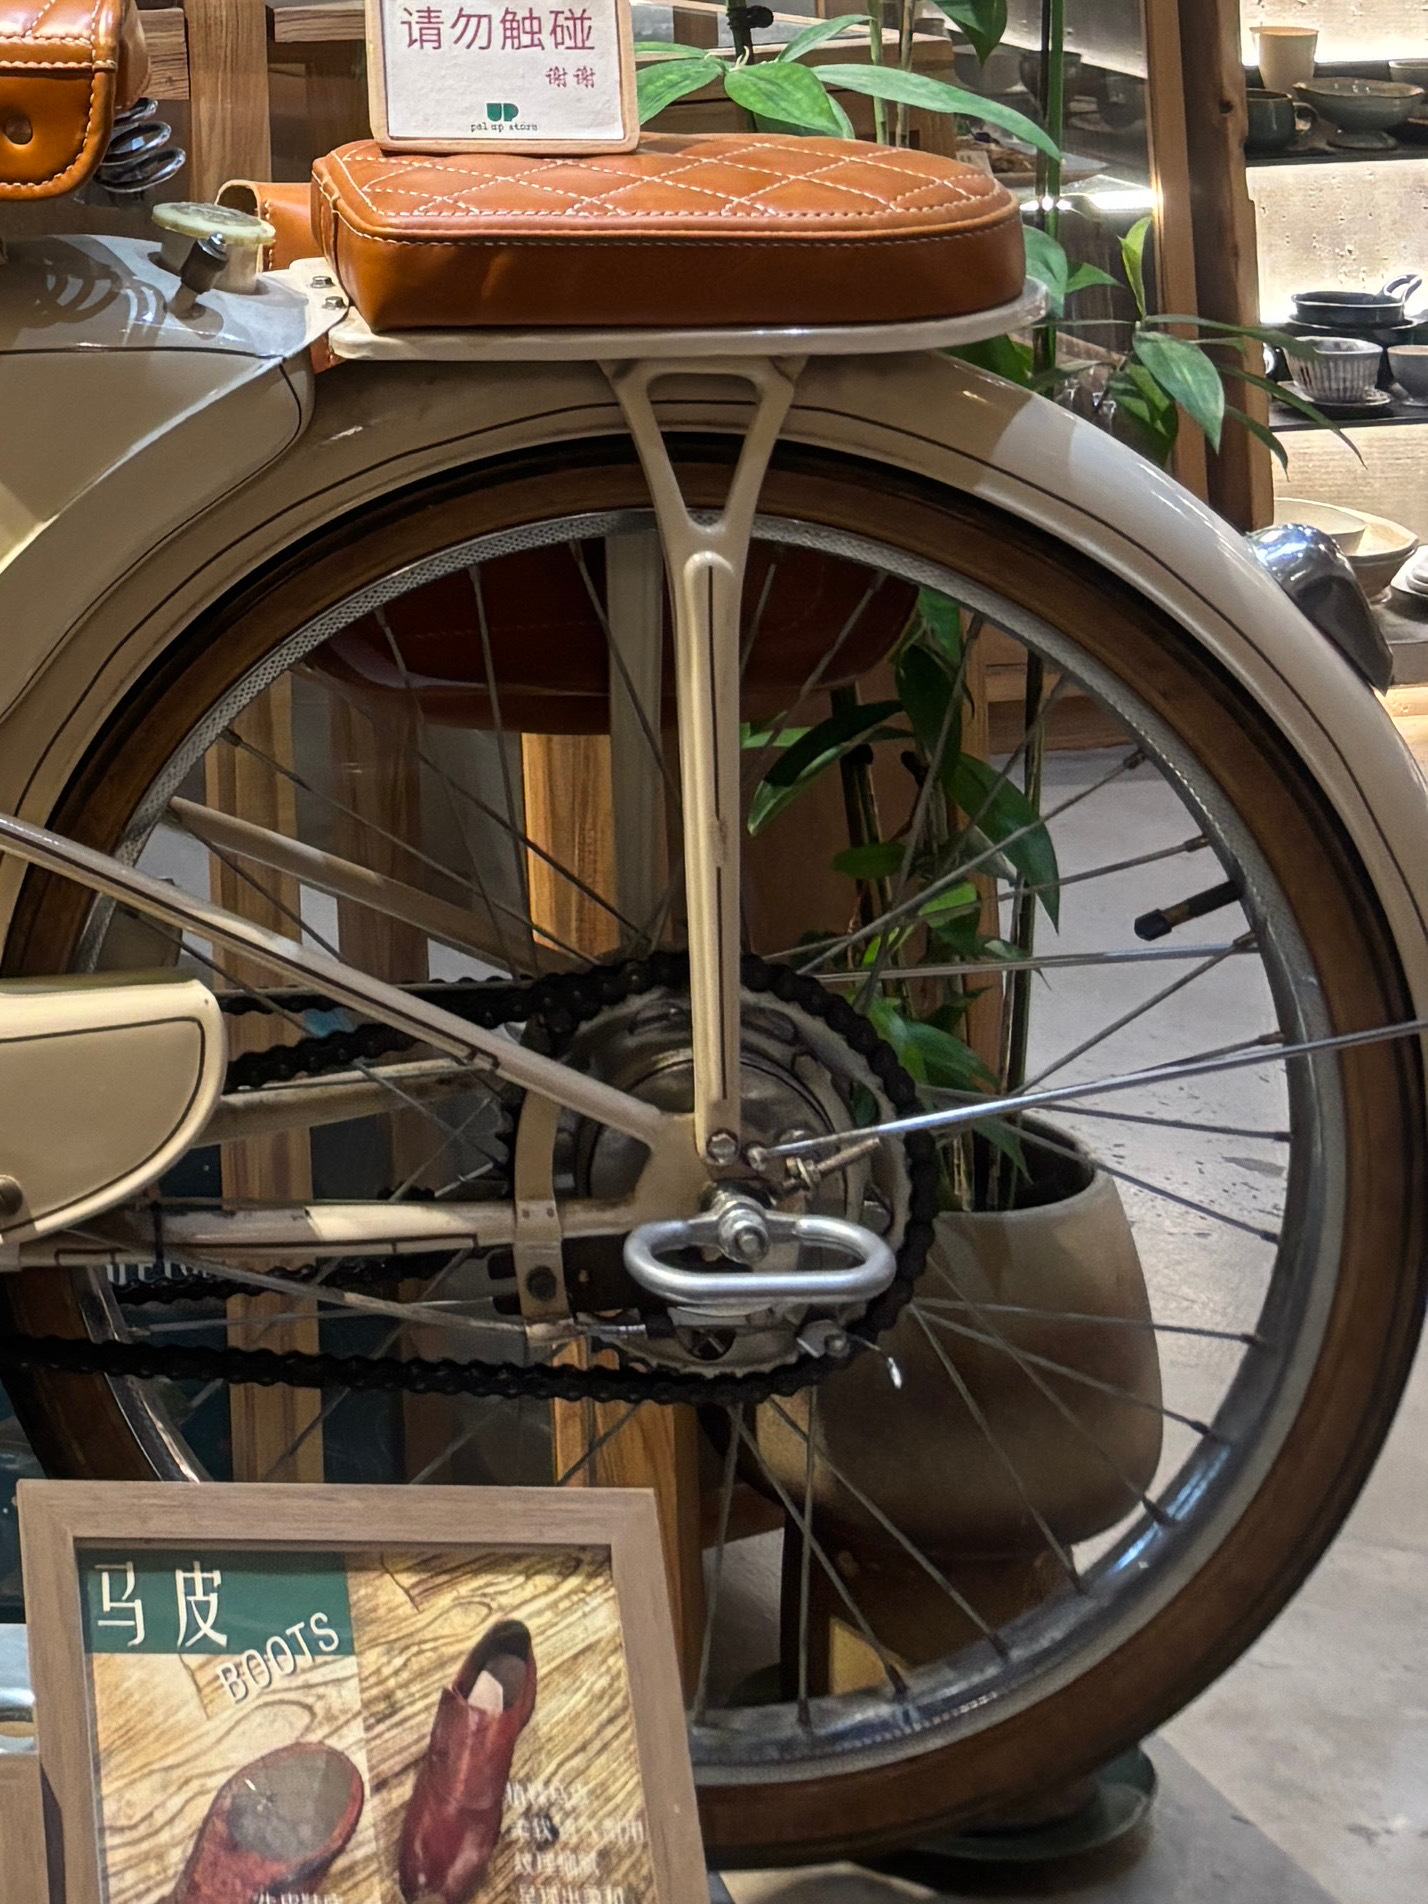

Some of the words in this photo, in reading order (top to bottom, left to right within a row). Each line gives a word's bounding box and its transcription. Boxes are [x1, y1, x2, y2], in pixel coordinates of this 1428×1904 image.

[400, 6, 596, 51] 请勿触碰
[545, 66, 596, 89] 谢谢
[94, 1562, 228, 1649] 马皮
[218, 1611, 341, 1705] BOOTS
